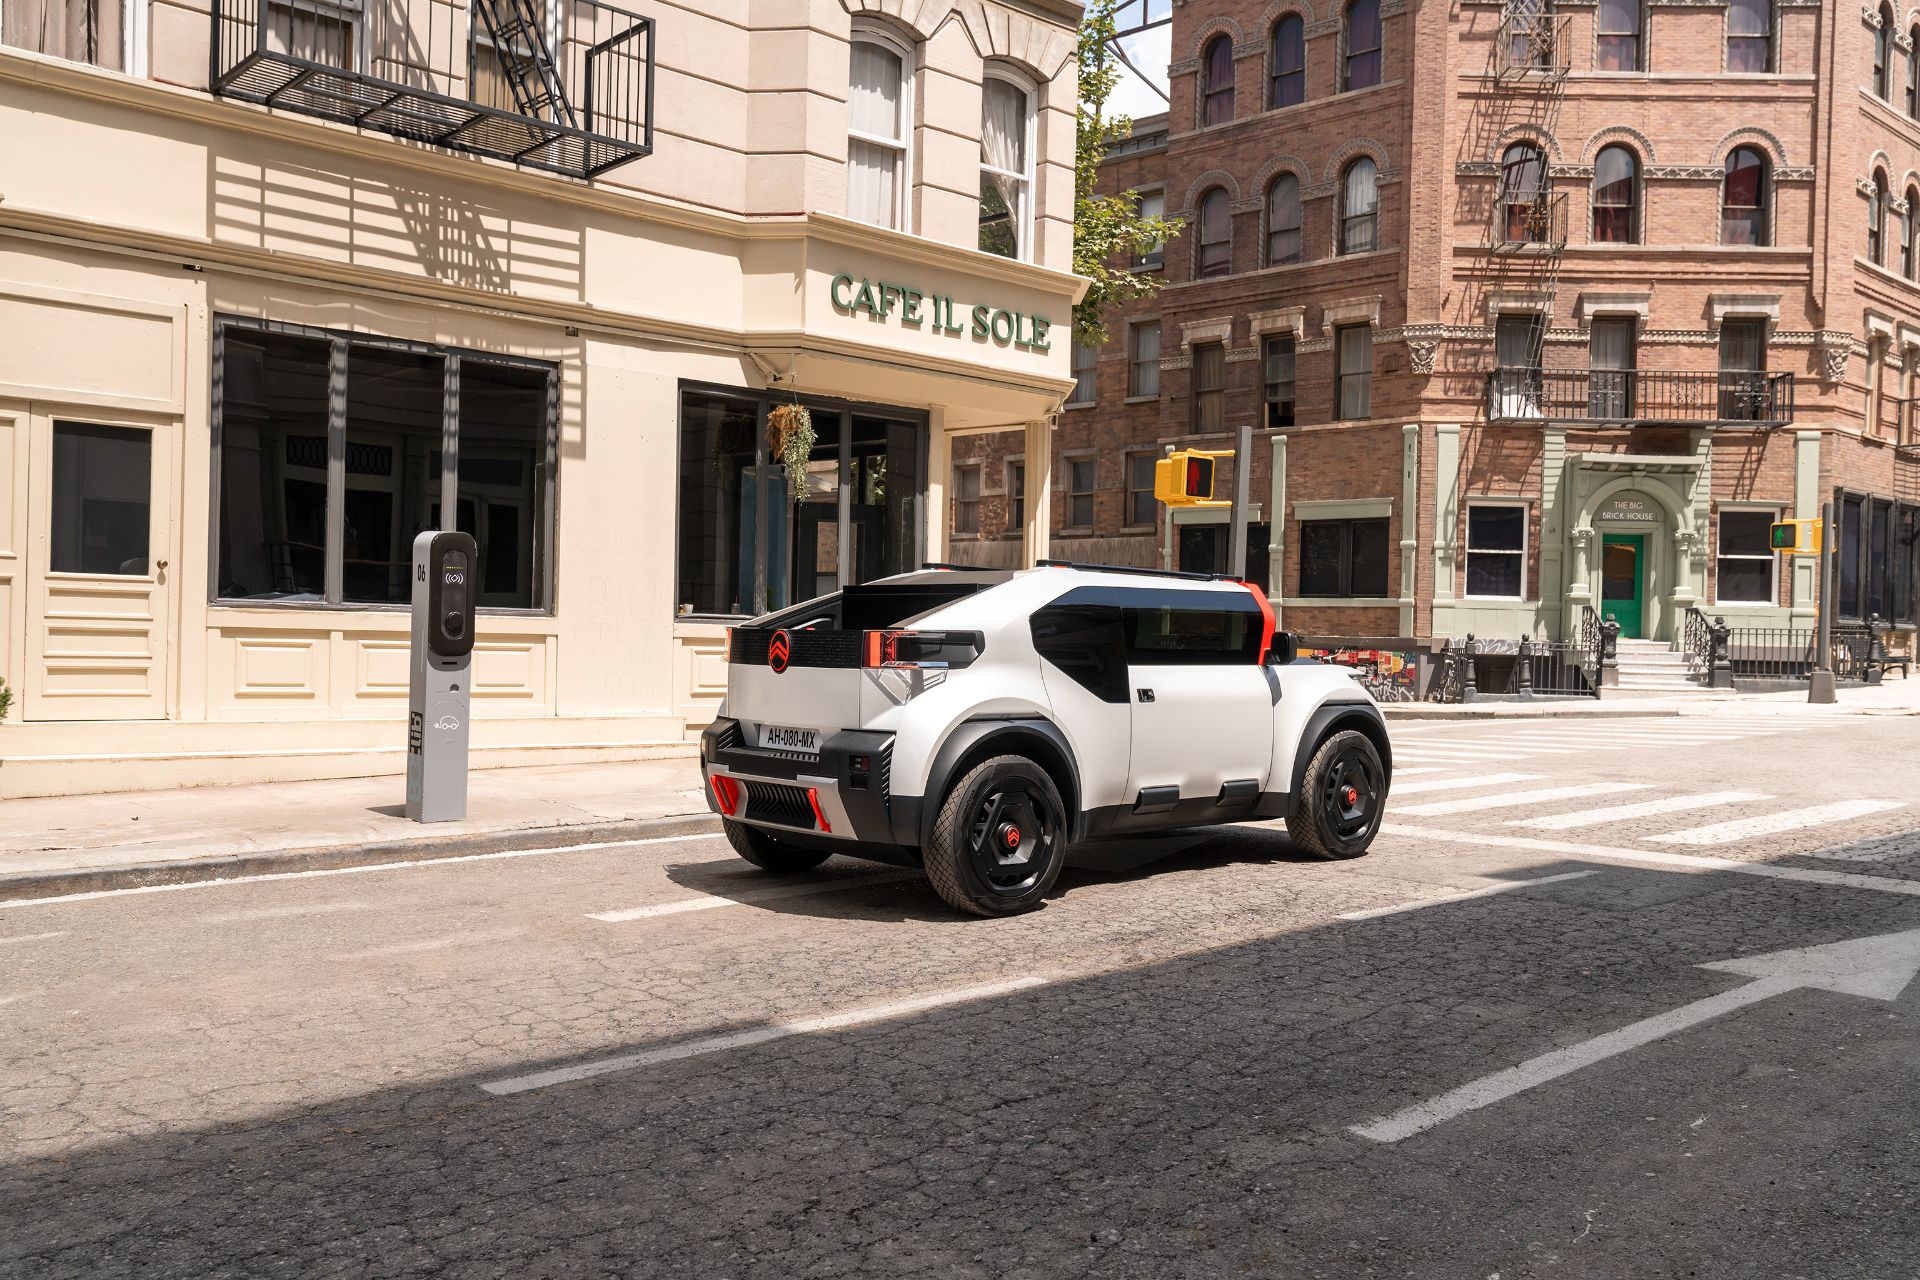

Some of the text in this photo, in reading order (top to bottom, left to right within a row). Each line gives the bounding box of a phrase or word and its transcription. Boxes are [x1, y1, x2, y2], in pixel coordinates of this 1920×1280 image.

[831, 272, 1052, 350] CAFE IL SOLE
[1614, 501, 1643, 510] THE BIG
[1602, 511, 1654, 521] BRICK HOUSE
[417, 563, 426, 582] 06
[767, 727, 816, 749] AH-080-MX
